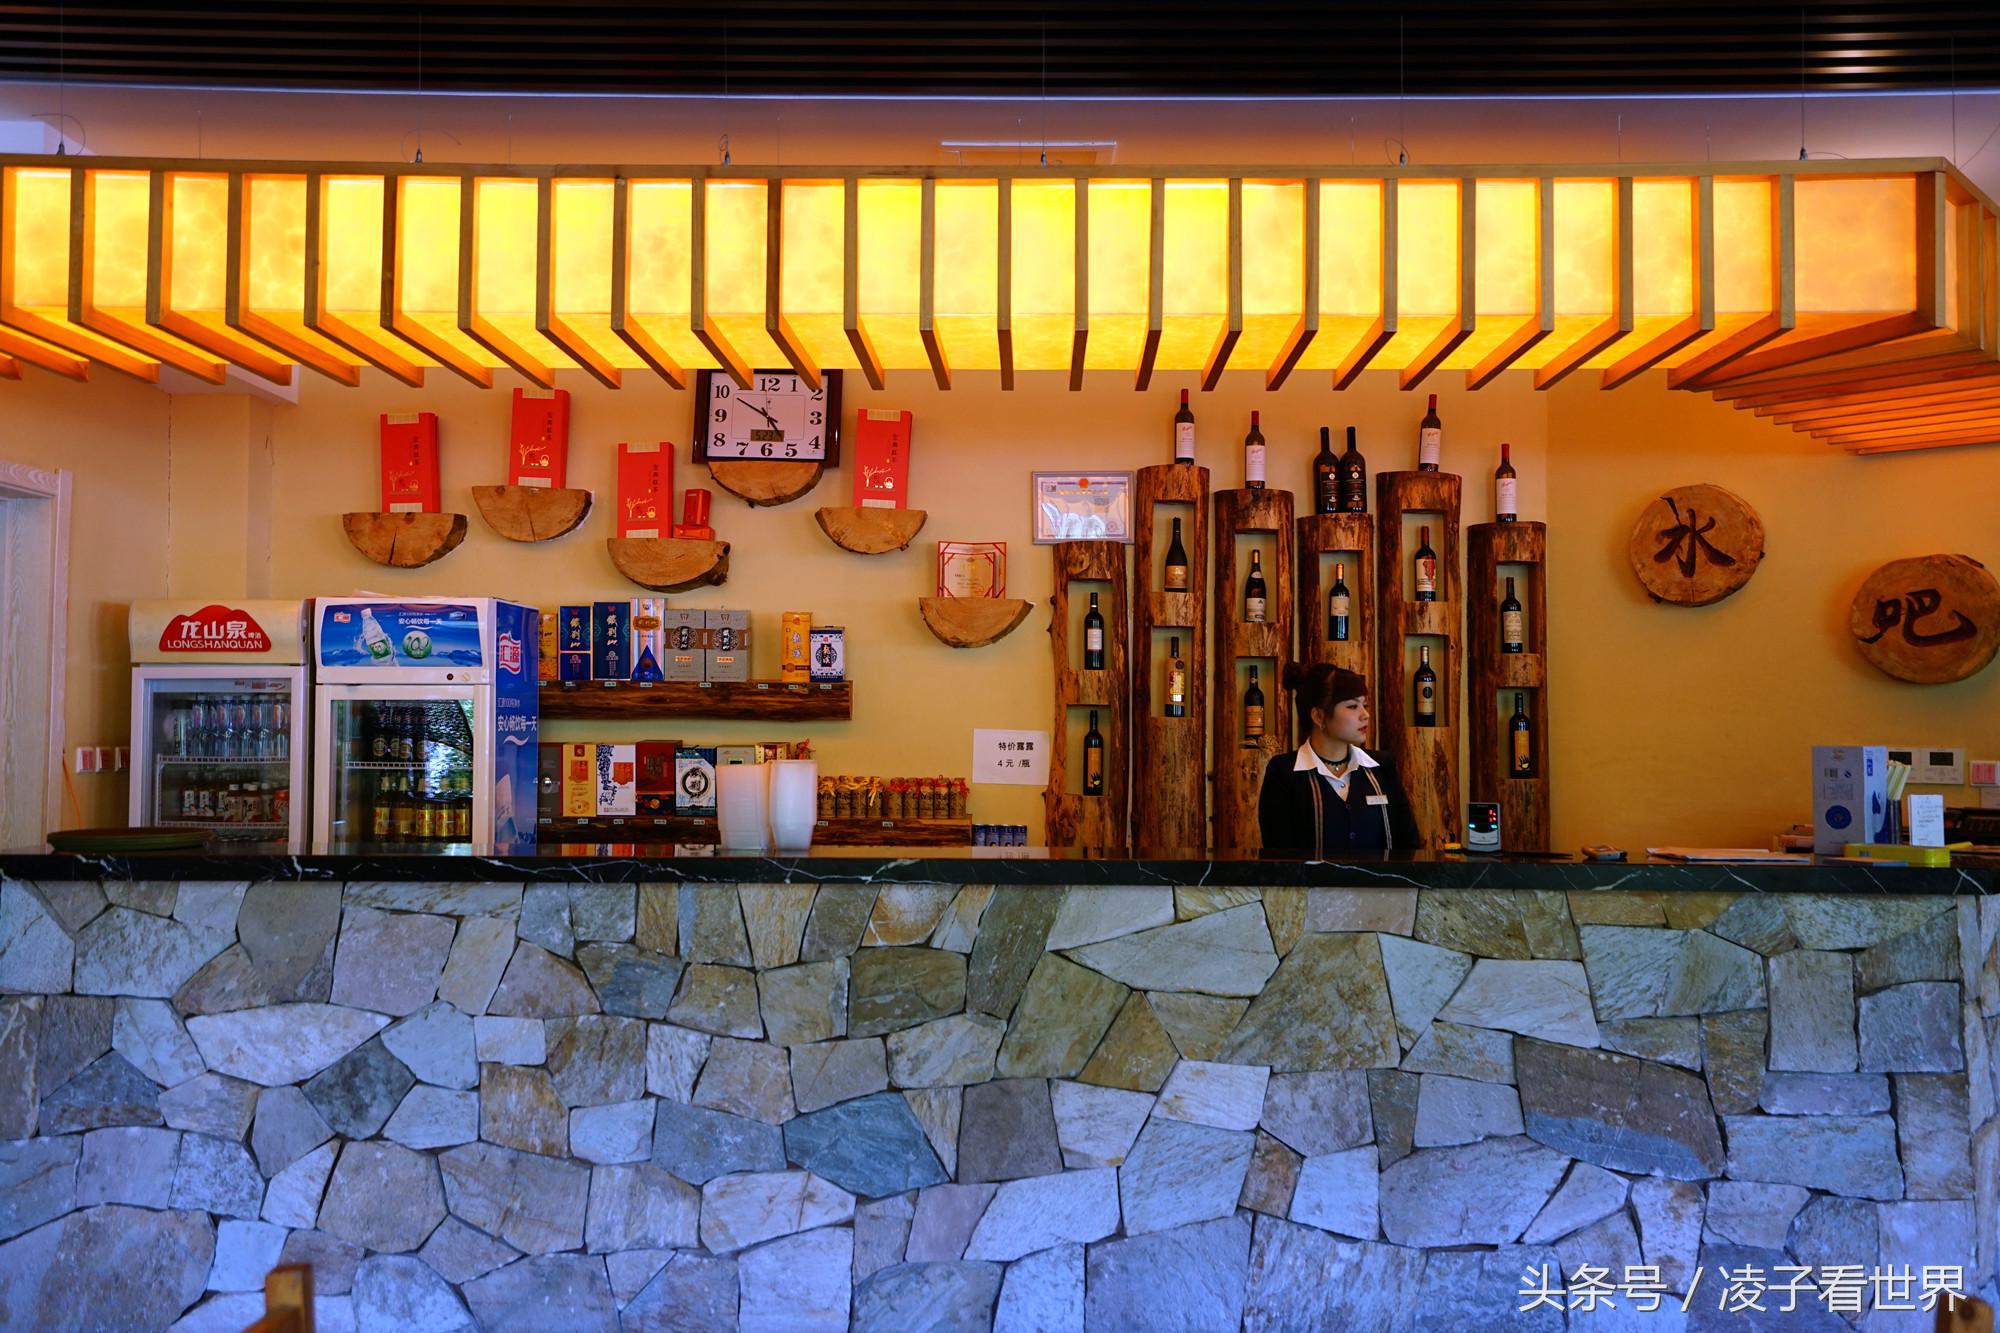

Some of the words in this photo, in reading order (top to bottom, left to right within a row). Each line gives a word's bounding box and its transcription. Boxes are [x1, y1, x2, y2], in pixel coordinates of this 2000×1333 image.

[715, 384, 730, 399] 10
[760, 377, 781, 392] 12
[790, 379, 798, 392] 1
[810, 387, 824, 401] 2
[714, 408, 727, 423] 9
[809, 410, 823, 425] 3
[713, 432, 726, 447] 8
[808, 435, 821, 450] 4
[736, 441, 749, 456] 7
[760, 442, 774, 457] 6
[784, 442, 798, 457] 5
[1653, 498, 1736, 578] 水
[1863, 588, 1978, 647] 吧
[181, 620, 248, 640] 龙山泉
[167, 639, 263, 649] LONGSHANQUAN
[498, 715, 537, 732] 安心畅饮每一天
[998, 741, 1034, 751] 特价露露
[997, 759, 1003, 768] 4
[1005, 759, 1014, 768] 元
